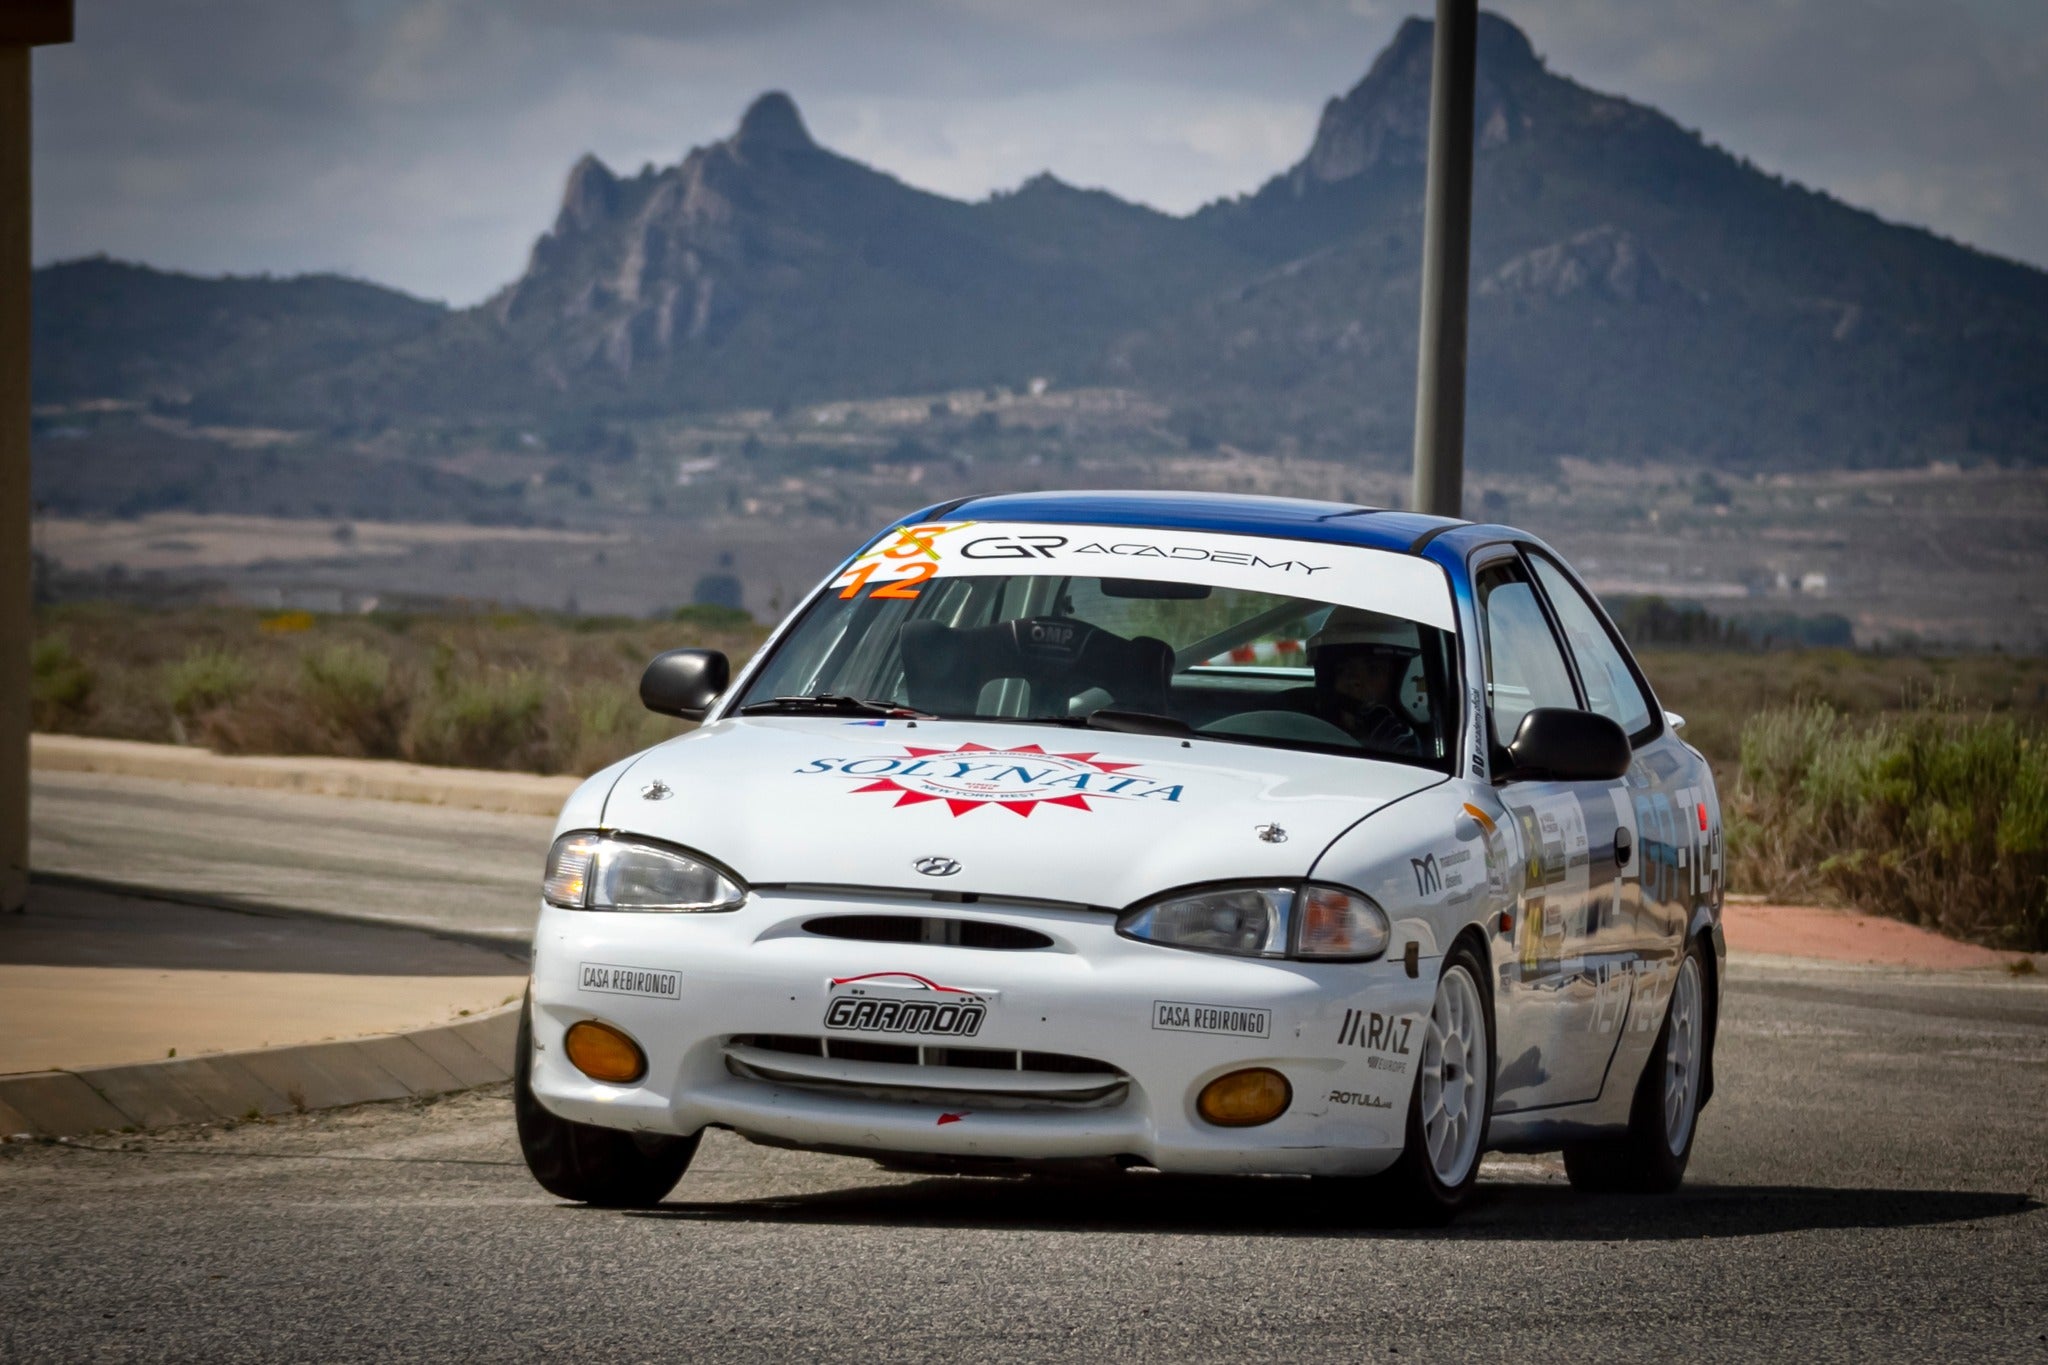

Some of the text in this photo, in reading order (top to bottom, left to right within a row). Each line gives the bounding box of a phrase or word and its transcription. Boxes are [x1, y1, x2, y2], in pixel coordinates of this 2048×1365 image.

[960, 535, 1331, 575] GR ACADEMY
[838, 562, 939, 599] 12
[794, 757, 1186, 802] SOLYNATA
[583, 966, 677, 995] CASA REBIRONGO
[824, 997, 987, 1037] GARMON
[1158, 1005, 1264, 1033] CASA REBIRONGO
